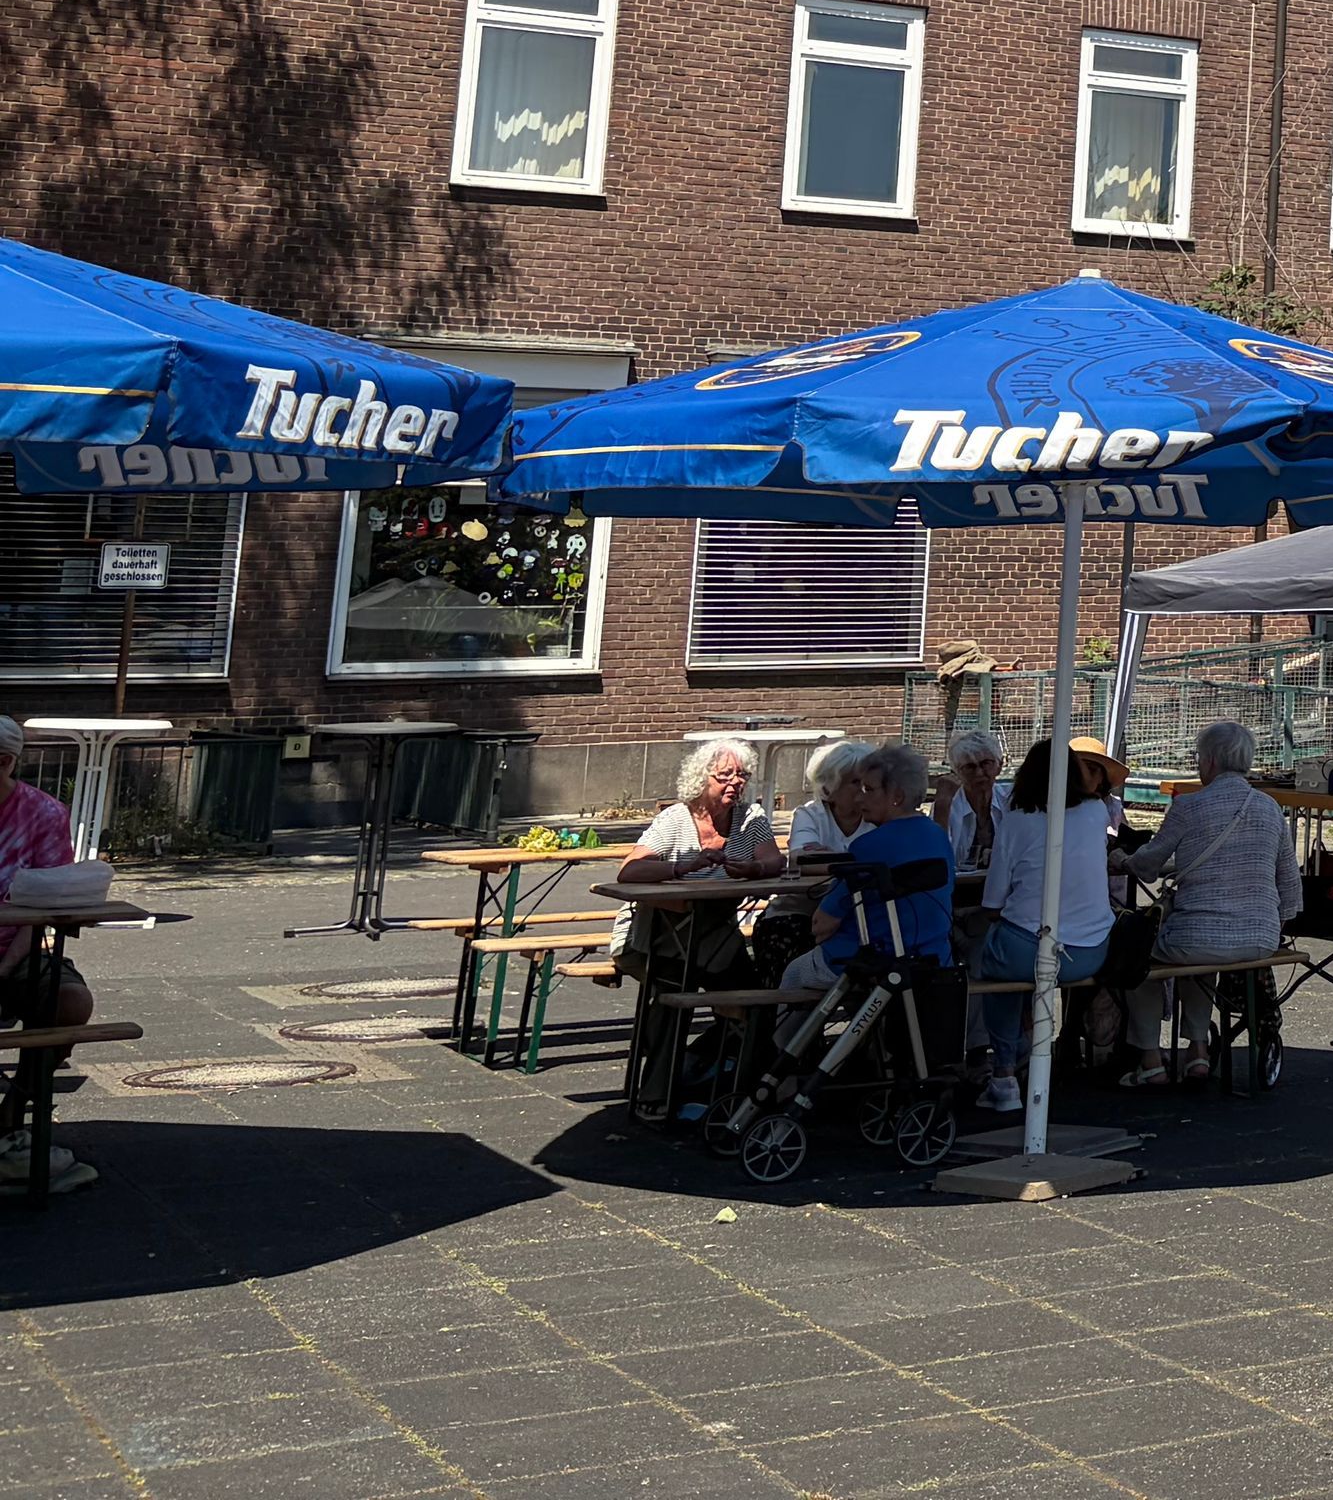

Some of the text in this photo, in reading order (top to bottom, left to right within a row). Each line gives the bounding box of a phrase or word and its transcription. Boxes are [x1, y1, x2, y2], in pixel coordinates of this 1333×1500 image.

[235, 363, 460, 458] Tucher
[889, 408, 1215, 473] Tucher
[112, 559, 158, 569] dauerhaft
[115, 547, 157, 558] Toiletten
[103, 571, 163, 583] geschlossen
[852, 998, 882, 1036] STYLUS
